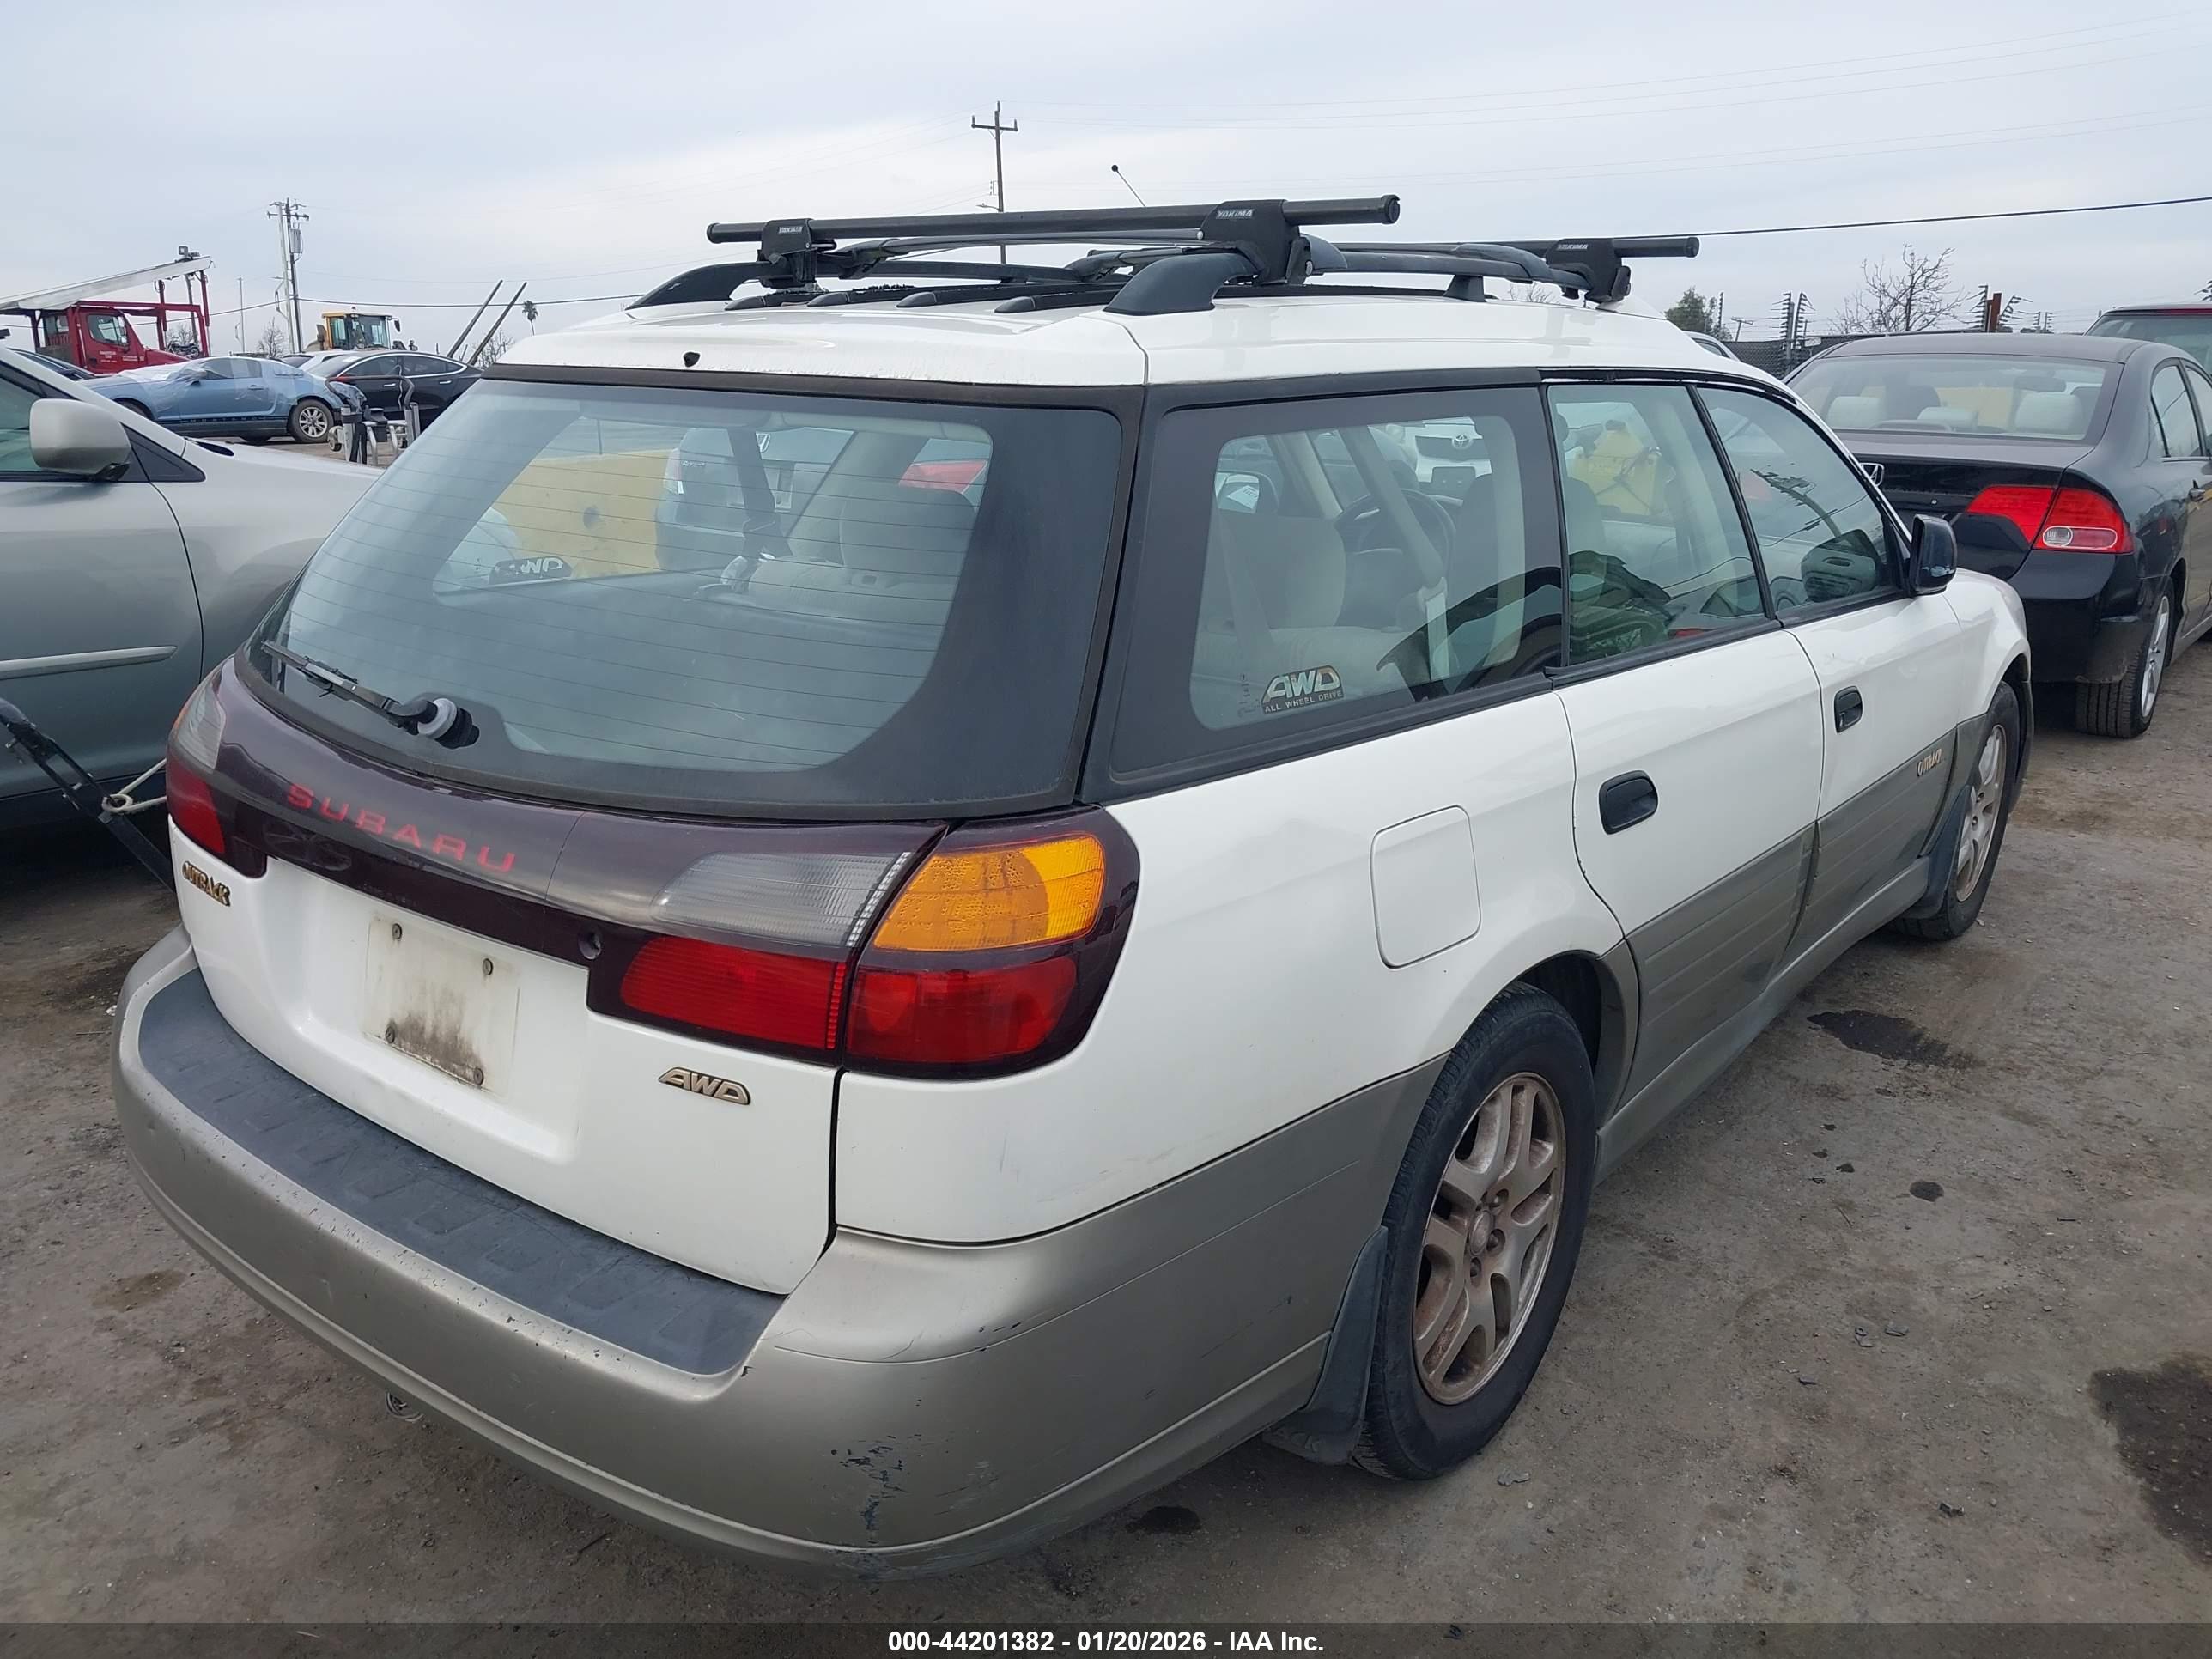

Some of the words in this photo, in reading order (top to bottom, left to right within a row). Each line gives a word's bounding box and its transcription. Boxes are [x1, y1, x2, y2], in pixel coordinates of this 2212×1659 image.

[1217, 209, 1253, 218] YAKIMA
[1262, 667, 1340, 704] AWD
[1264, 703, 1282, 713] ALL
[1285, 696, 1316, 708] WHEEL
[1318, 690, 1342, 702] DRIVE
[287, 783, 515, 873] SUBARU
[658, 1066, 751, 1106] AWD
